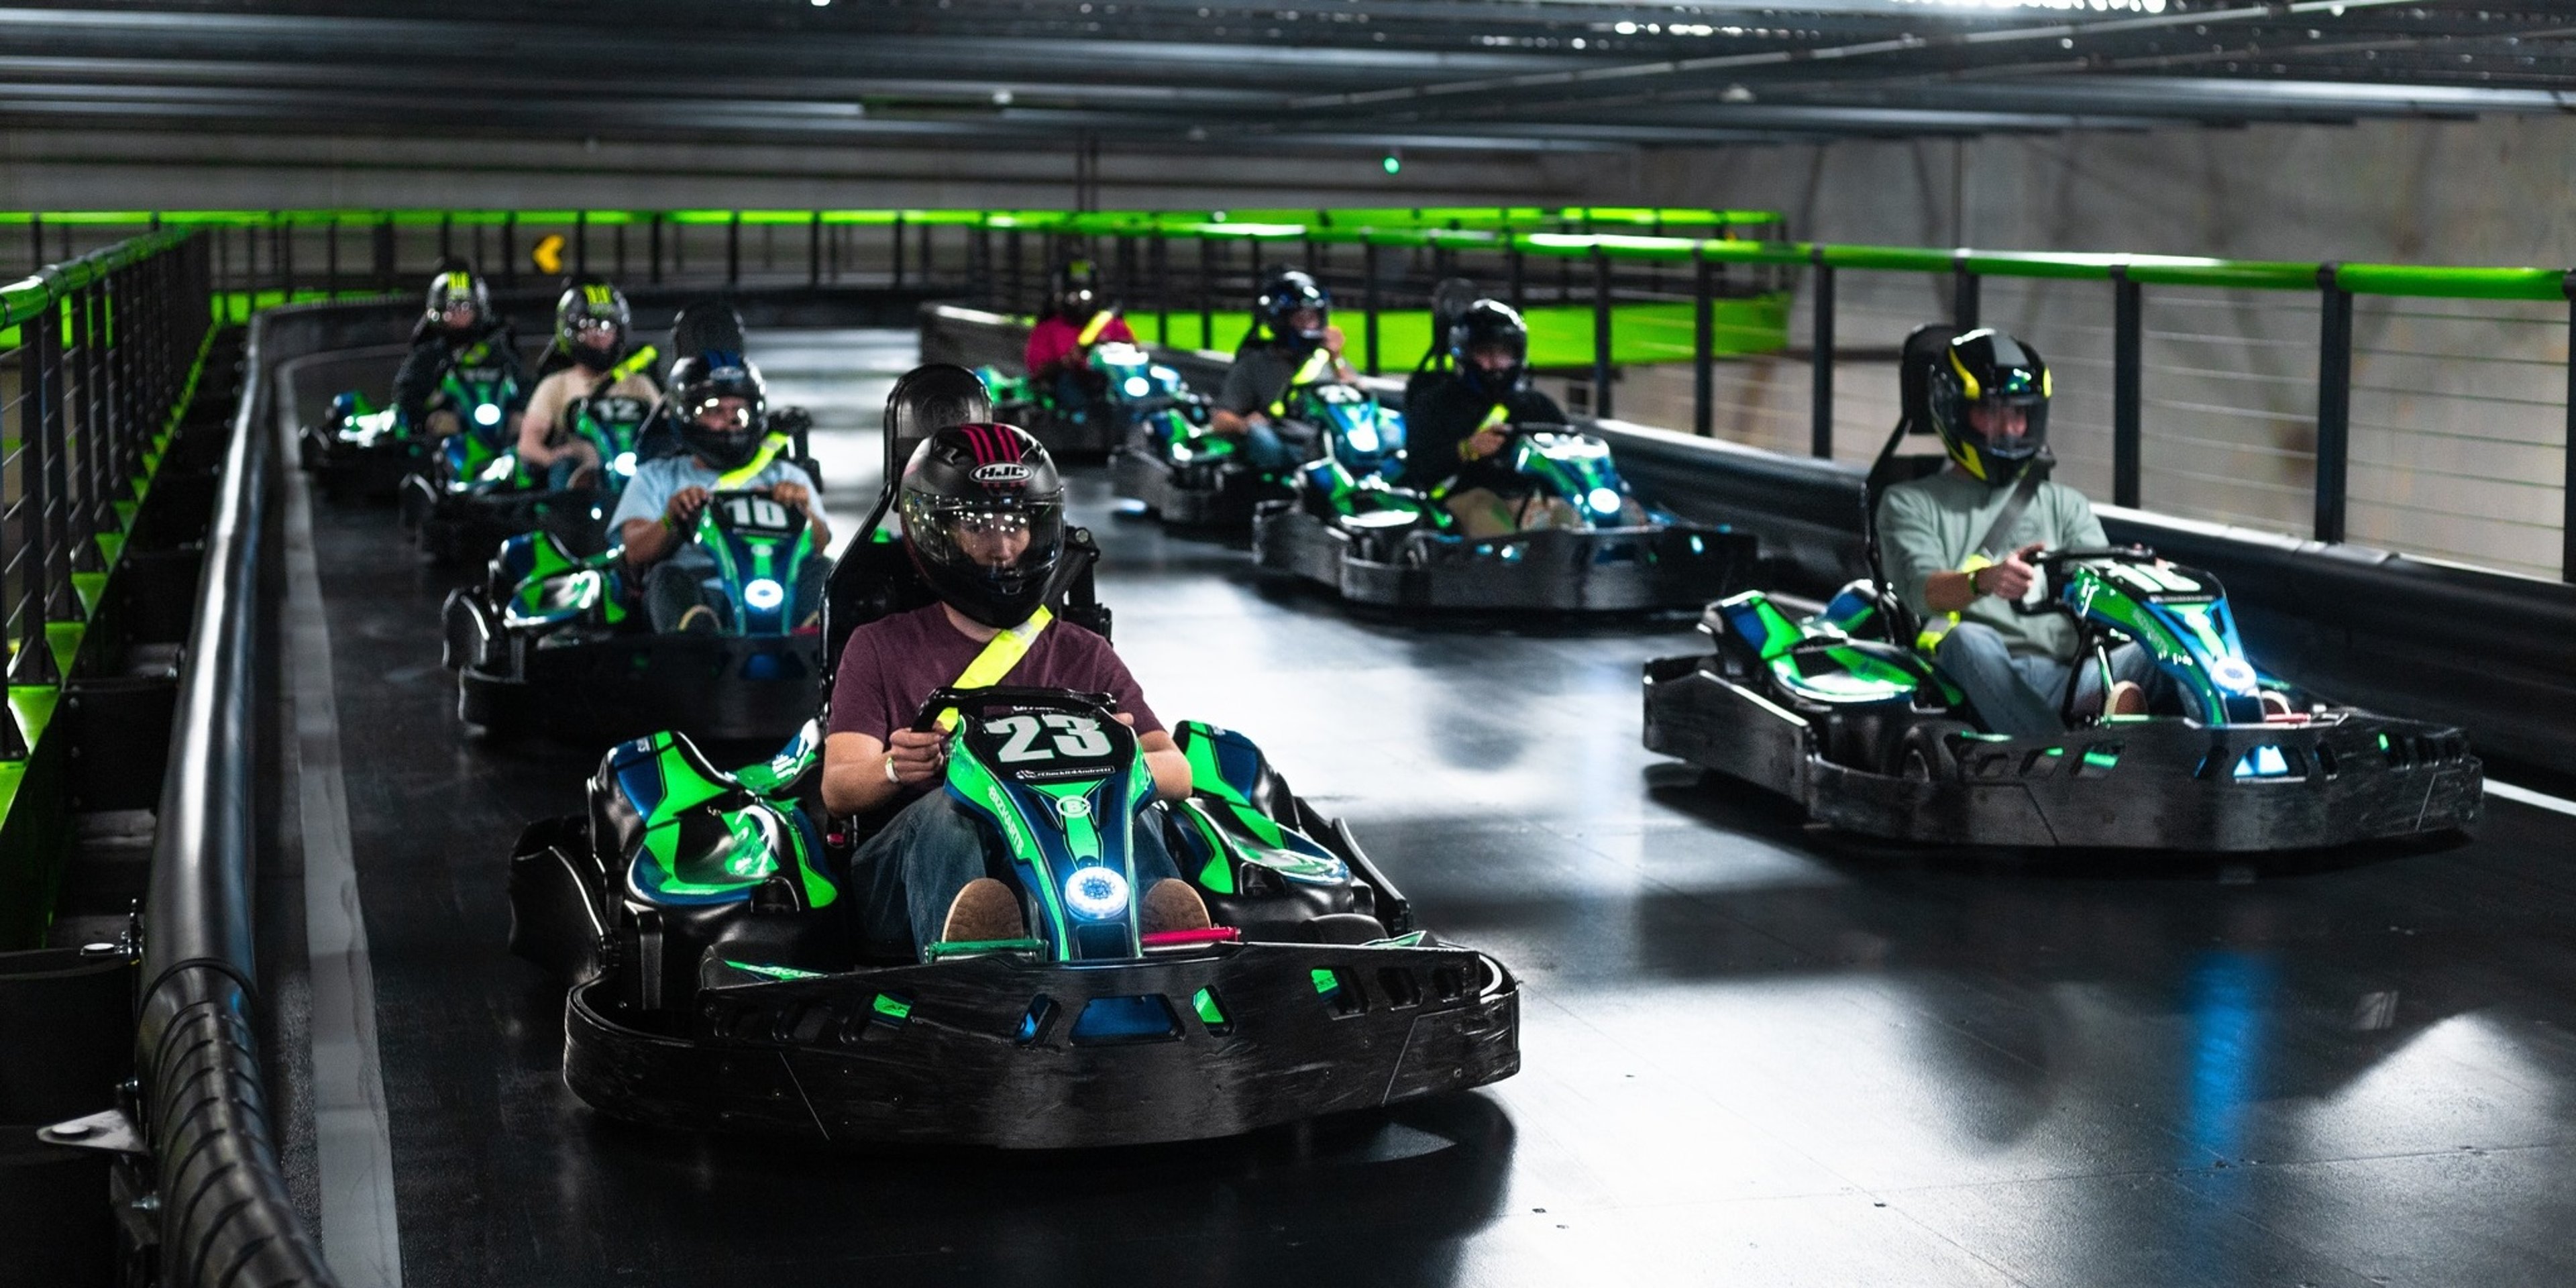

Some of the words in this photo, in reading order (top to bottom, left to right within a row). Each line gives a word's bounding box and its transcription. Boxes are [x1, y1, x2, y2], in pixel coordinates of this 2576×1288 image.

[594, 399, 642, 420] 12
[979, 466, 1024, 478] HJC
[722, 498, 788, 528] 10
[985, 714, 1112, 762] 23
